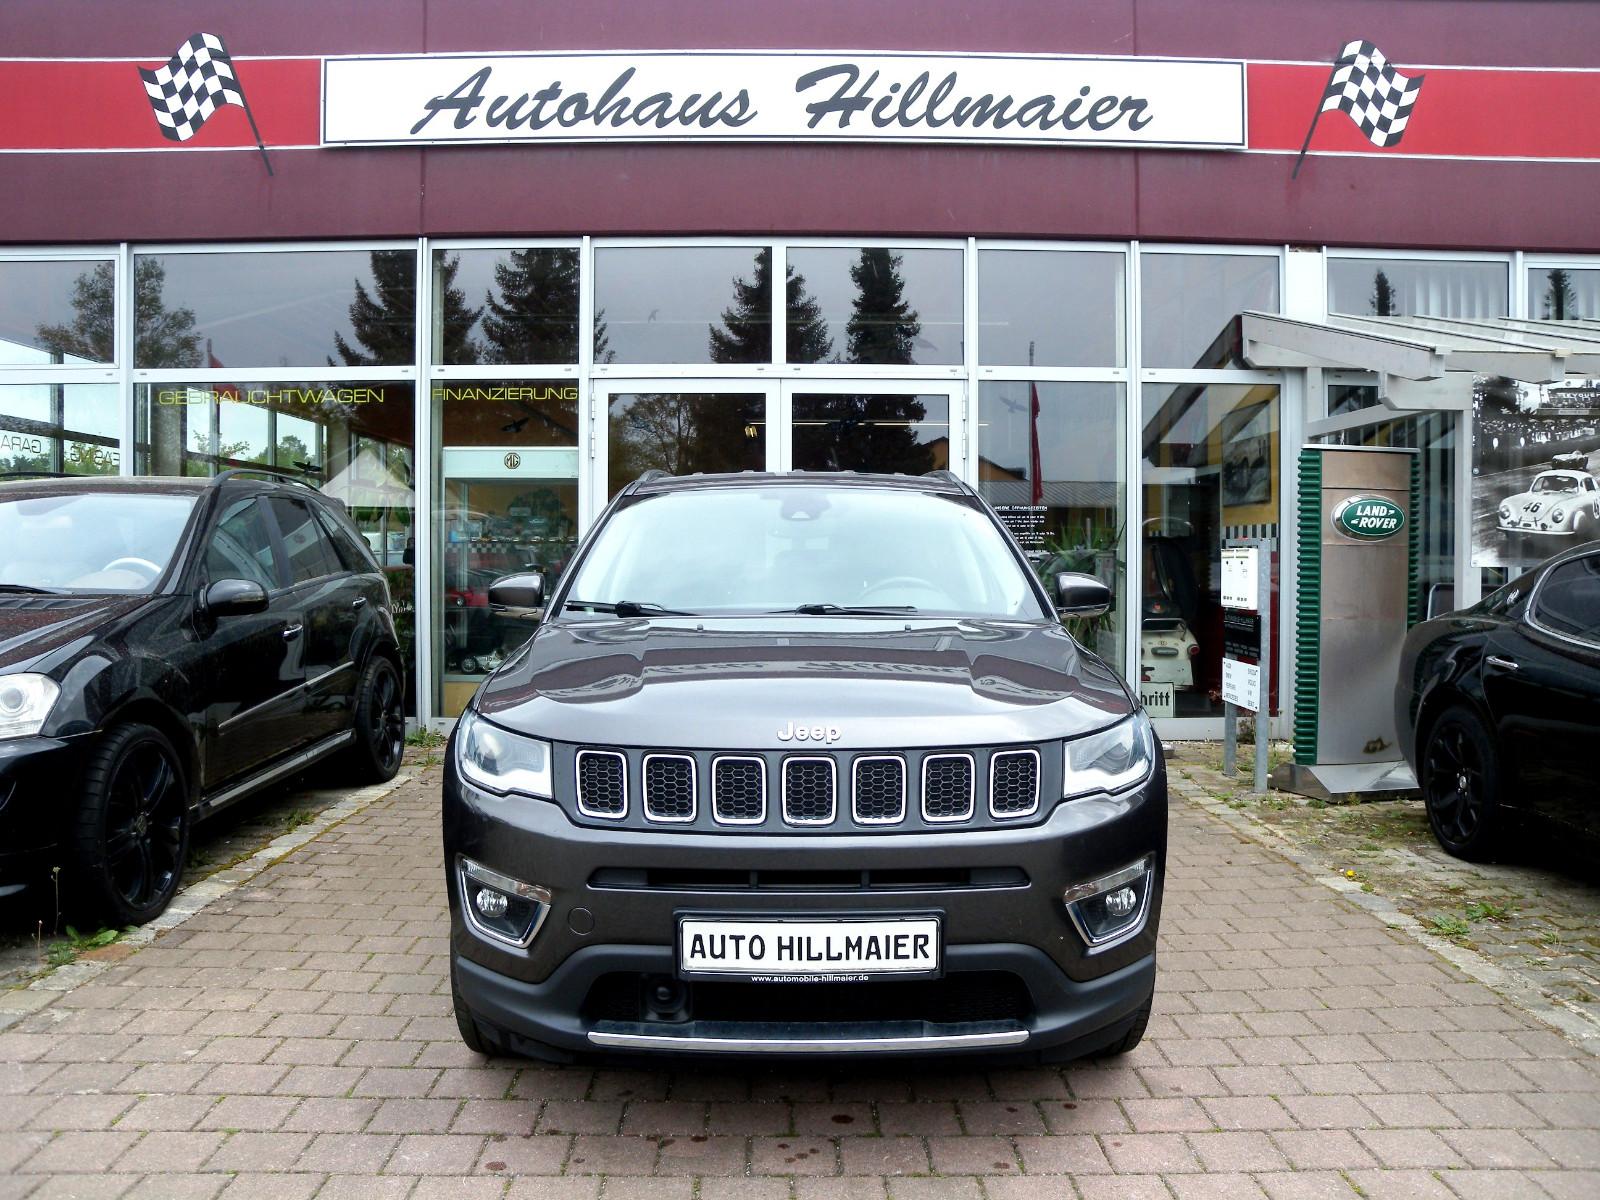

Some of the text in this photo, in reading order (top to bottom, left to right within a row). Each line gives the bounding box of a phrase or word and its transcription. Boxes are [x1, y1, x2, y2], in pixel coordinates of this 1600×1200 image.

[410, 64, 1154, 138] Autohaus Hillmaier
[158, 388, 385, 406] GEBRAUCHTWAGEN
[432, 387, 579, 401] FINANZIERUNG
[505, 454, 520, 468] MG
[1356, 505, 1388, 517] LAND
[1522, 502, 1542, 513] 46
[1358, 517, 1397, 529] ROVER
[777, 721, 842, 744] Jeep
[691, 934, 929, 960] AUTO HILLMAIER
[751, 974, 869, 983] www.automobile-hillmaier.de
